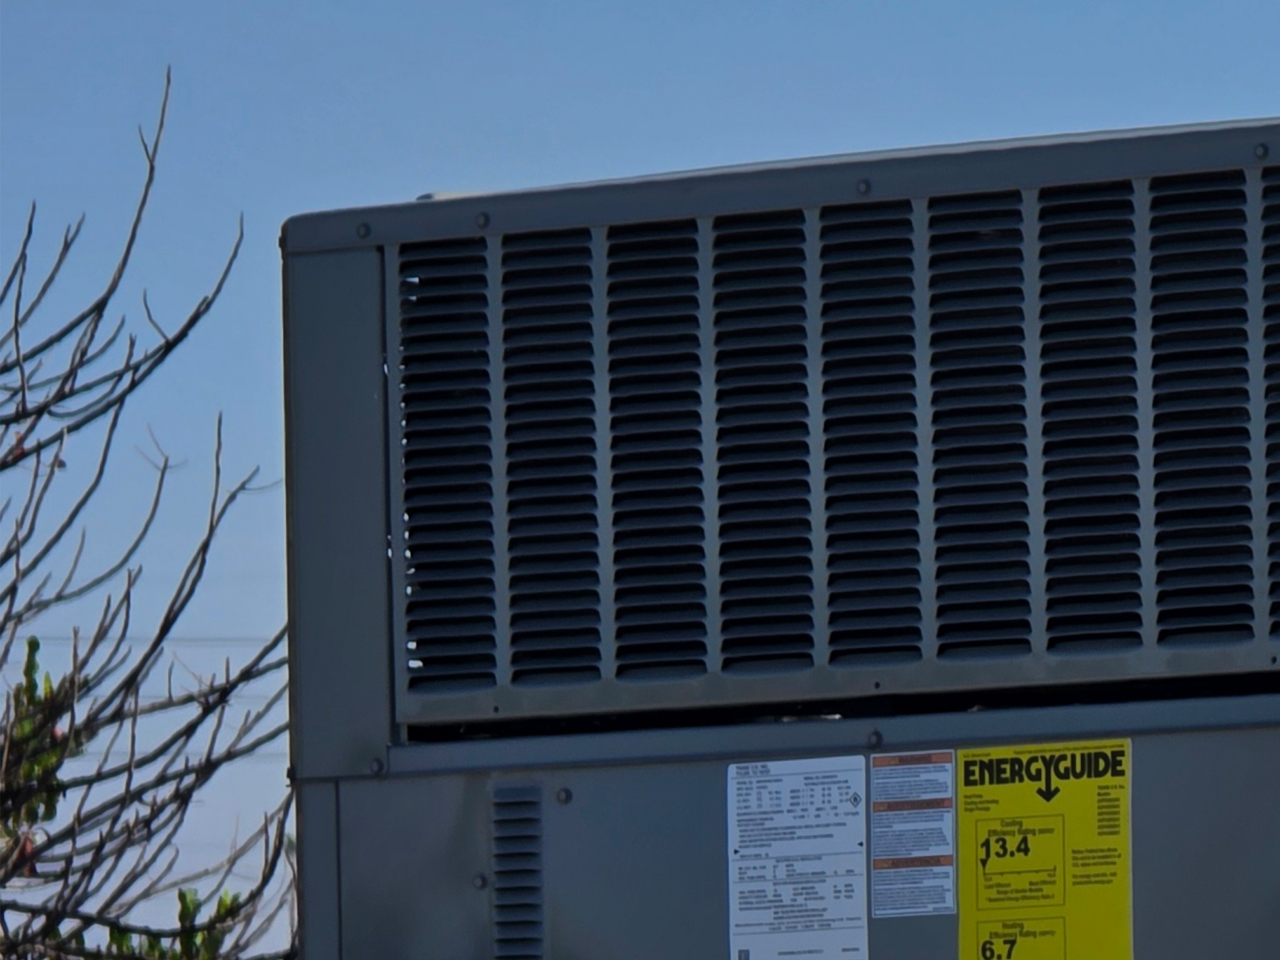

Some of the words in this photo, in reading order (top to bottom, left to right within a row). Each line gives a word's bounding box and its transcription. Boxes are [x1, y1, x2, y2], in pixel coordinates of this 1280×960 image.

[964, 750, 1125, 786] ENERGYGUIDE
[1001, 820, 1023, 828] Cooling
[1018, 828, 1036, 836] Rating
[980, 836, 1030, 858] 13.4
[981, 939, 1017, 960] 6.7
